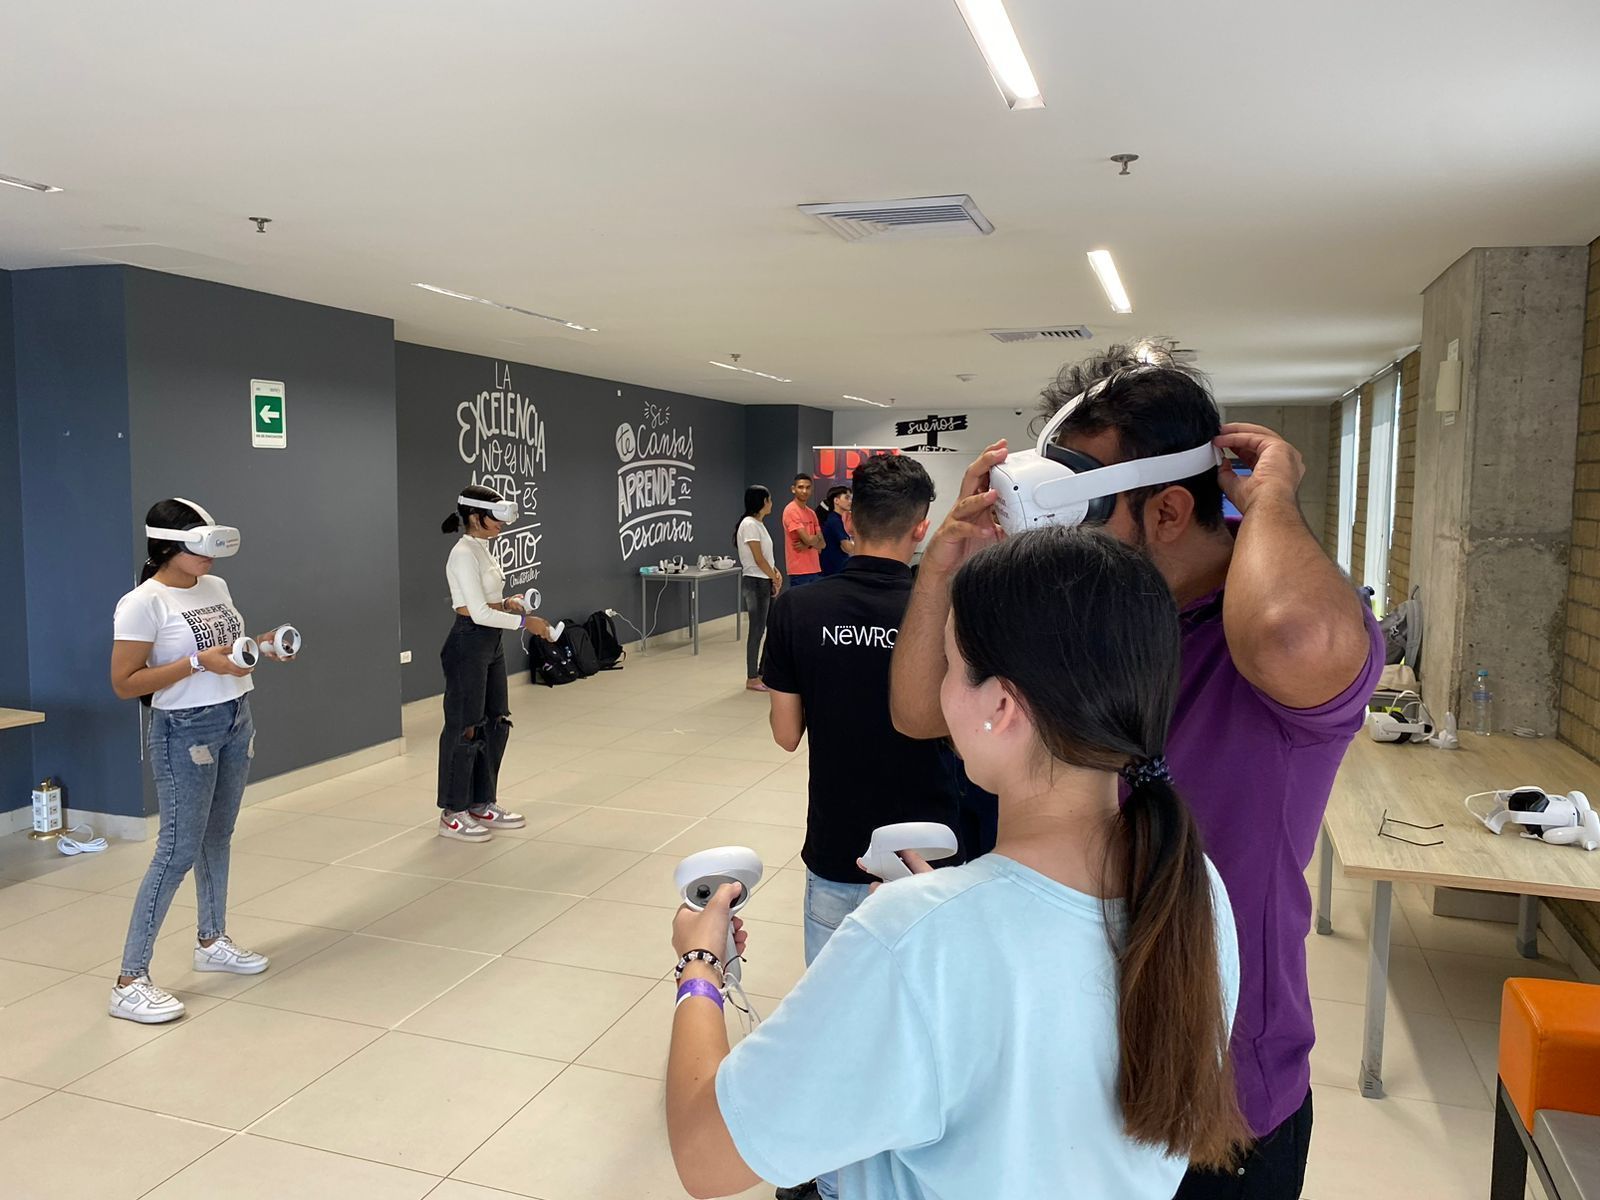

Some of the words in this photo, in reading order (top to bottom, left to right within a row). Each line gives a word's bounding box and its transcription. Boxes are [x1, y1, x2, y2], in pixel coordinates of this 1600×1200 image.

[495, 361, 511, 390] LA
[456, 391, 546, 473] EXCELENCIA
[617, 426, 635, 458] te
[637, 424, 693, 460] Cansas
[908, 418, 961, 434] sueños
[482, 439, 502, 472] NO
[519, 444, 535, 478] UN
[523, 488, 538, 509] es
[618, 467, 676, 523] APRENDE
[681, 483, 691, 494] a
[492, 532, 542, 571] ÁBITO
[620, 517, 693, 561] Descansar
